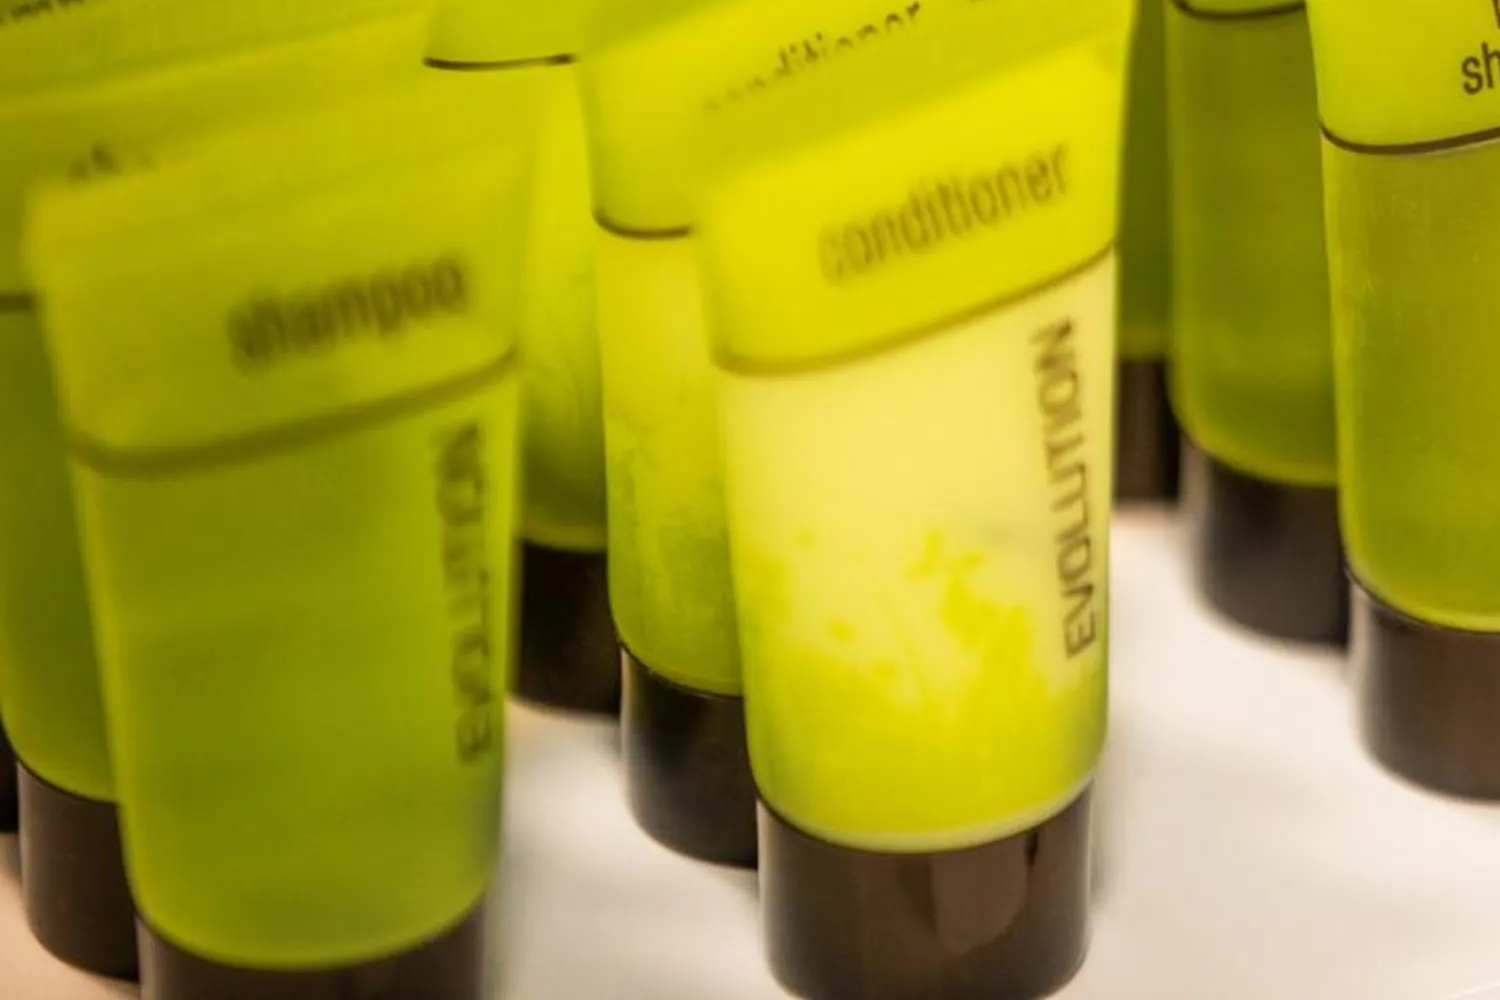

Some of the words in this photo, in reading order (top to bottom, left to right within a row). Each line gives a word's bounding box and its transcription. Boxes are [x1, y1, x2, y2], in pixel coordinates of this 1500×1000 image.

[815, 141, 1071, 287] conditioner
[227, 252, 468, 368] shampoo
[1028, 313, 1098, 661] EVOLUTION
